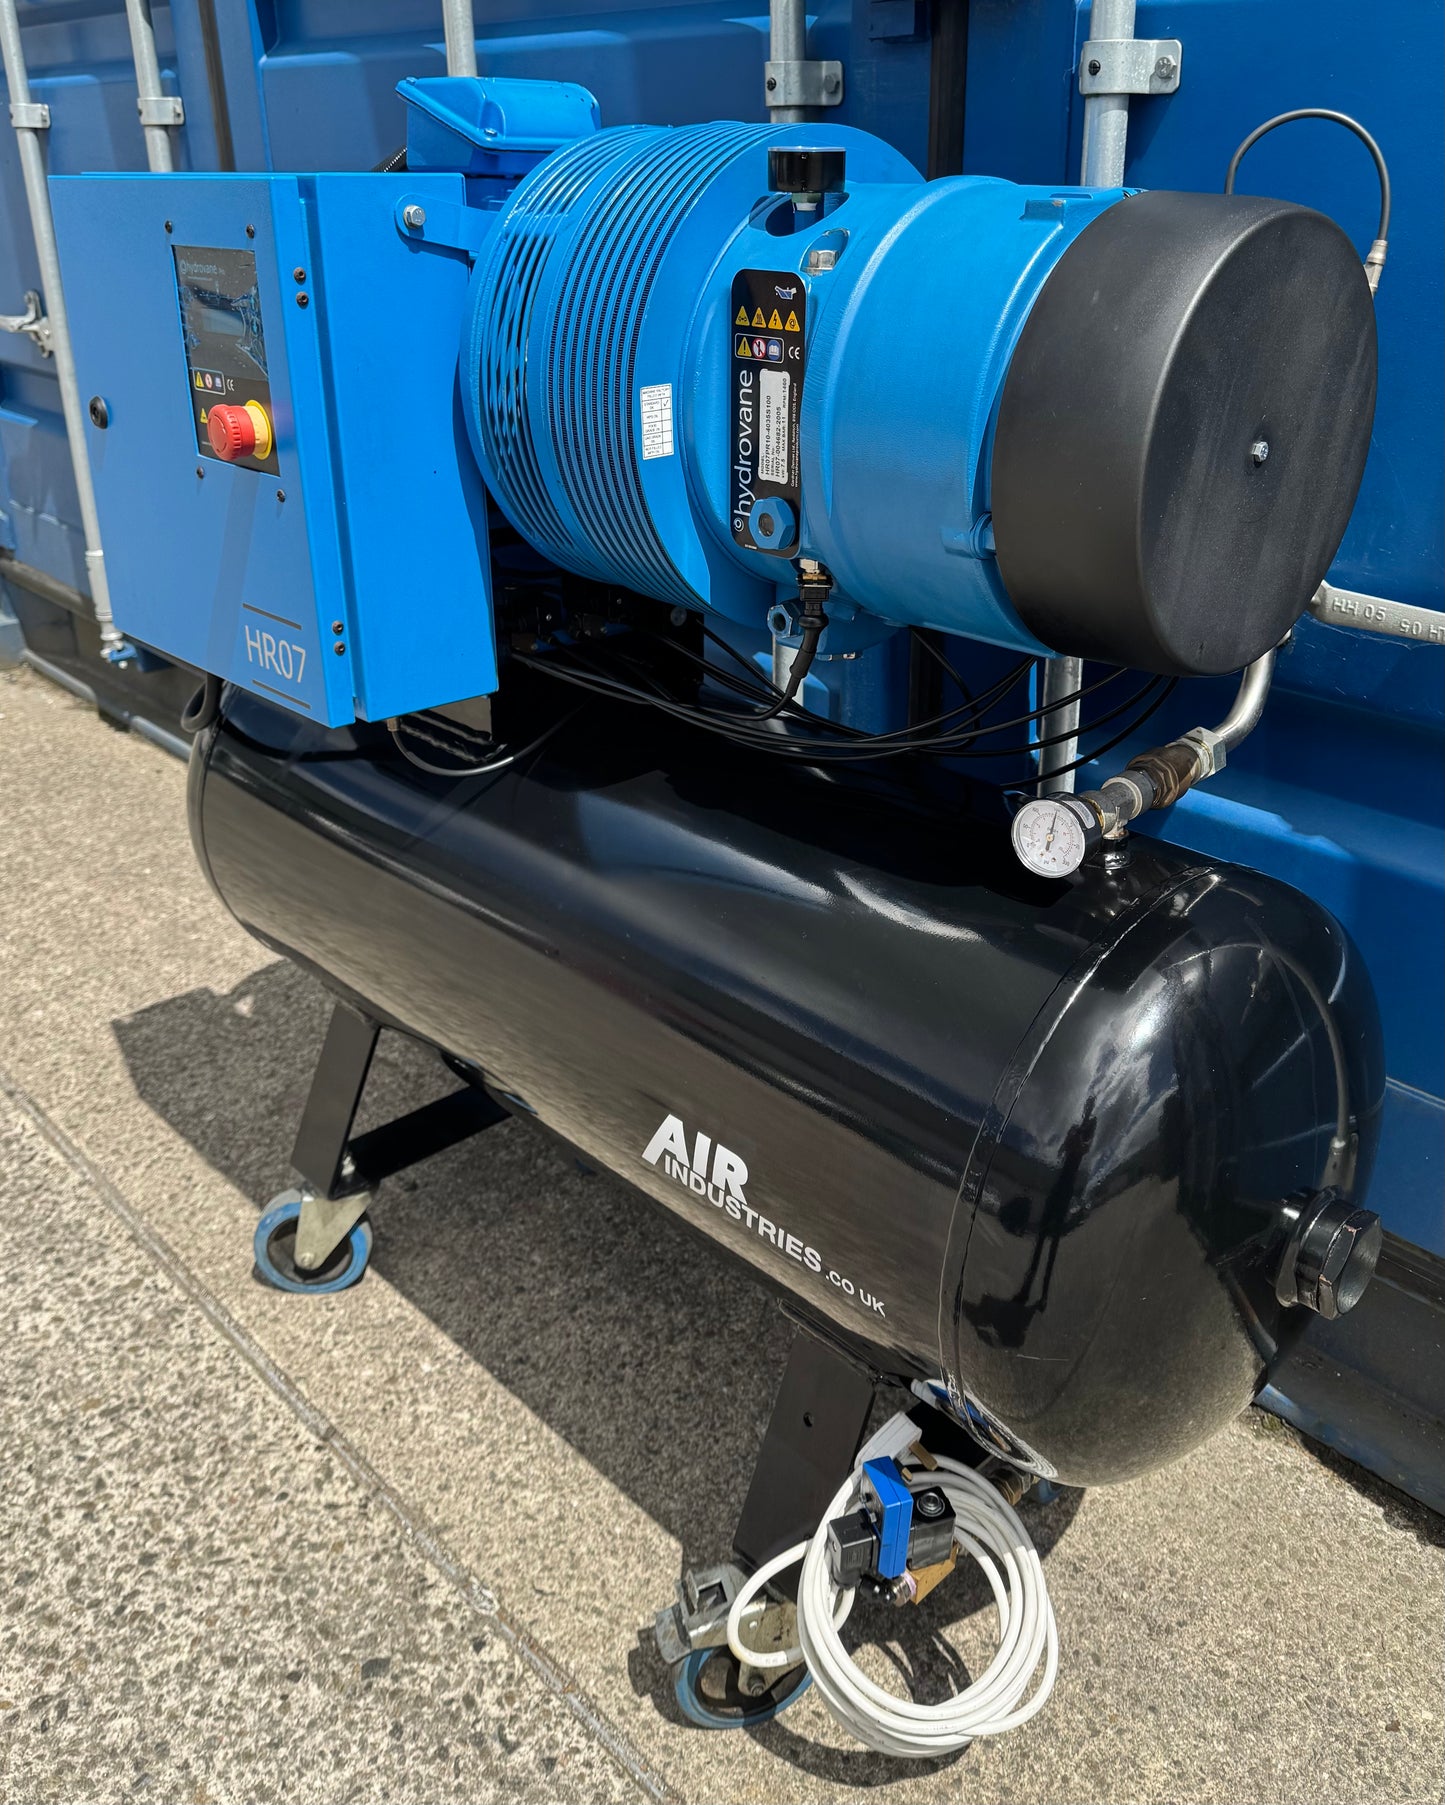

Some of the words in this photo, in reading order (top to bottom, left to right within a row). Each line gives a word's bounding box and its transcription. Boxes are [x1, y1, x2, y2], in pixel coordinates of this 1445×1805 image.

[788, 346, 800, 360] CE
[734, 369, 756, 517] hydrovane
[1363, 603, 1387, 622] 05
[245, 624, 306, 684] HR07
[641, 1113, 749, 1206] AIR
[664, 1154, 823, 1273] INDUSTRIES
[859, 1288, 886, 1318] UK
